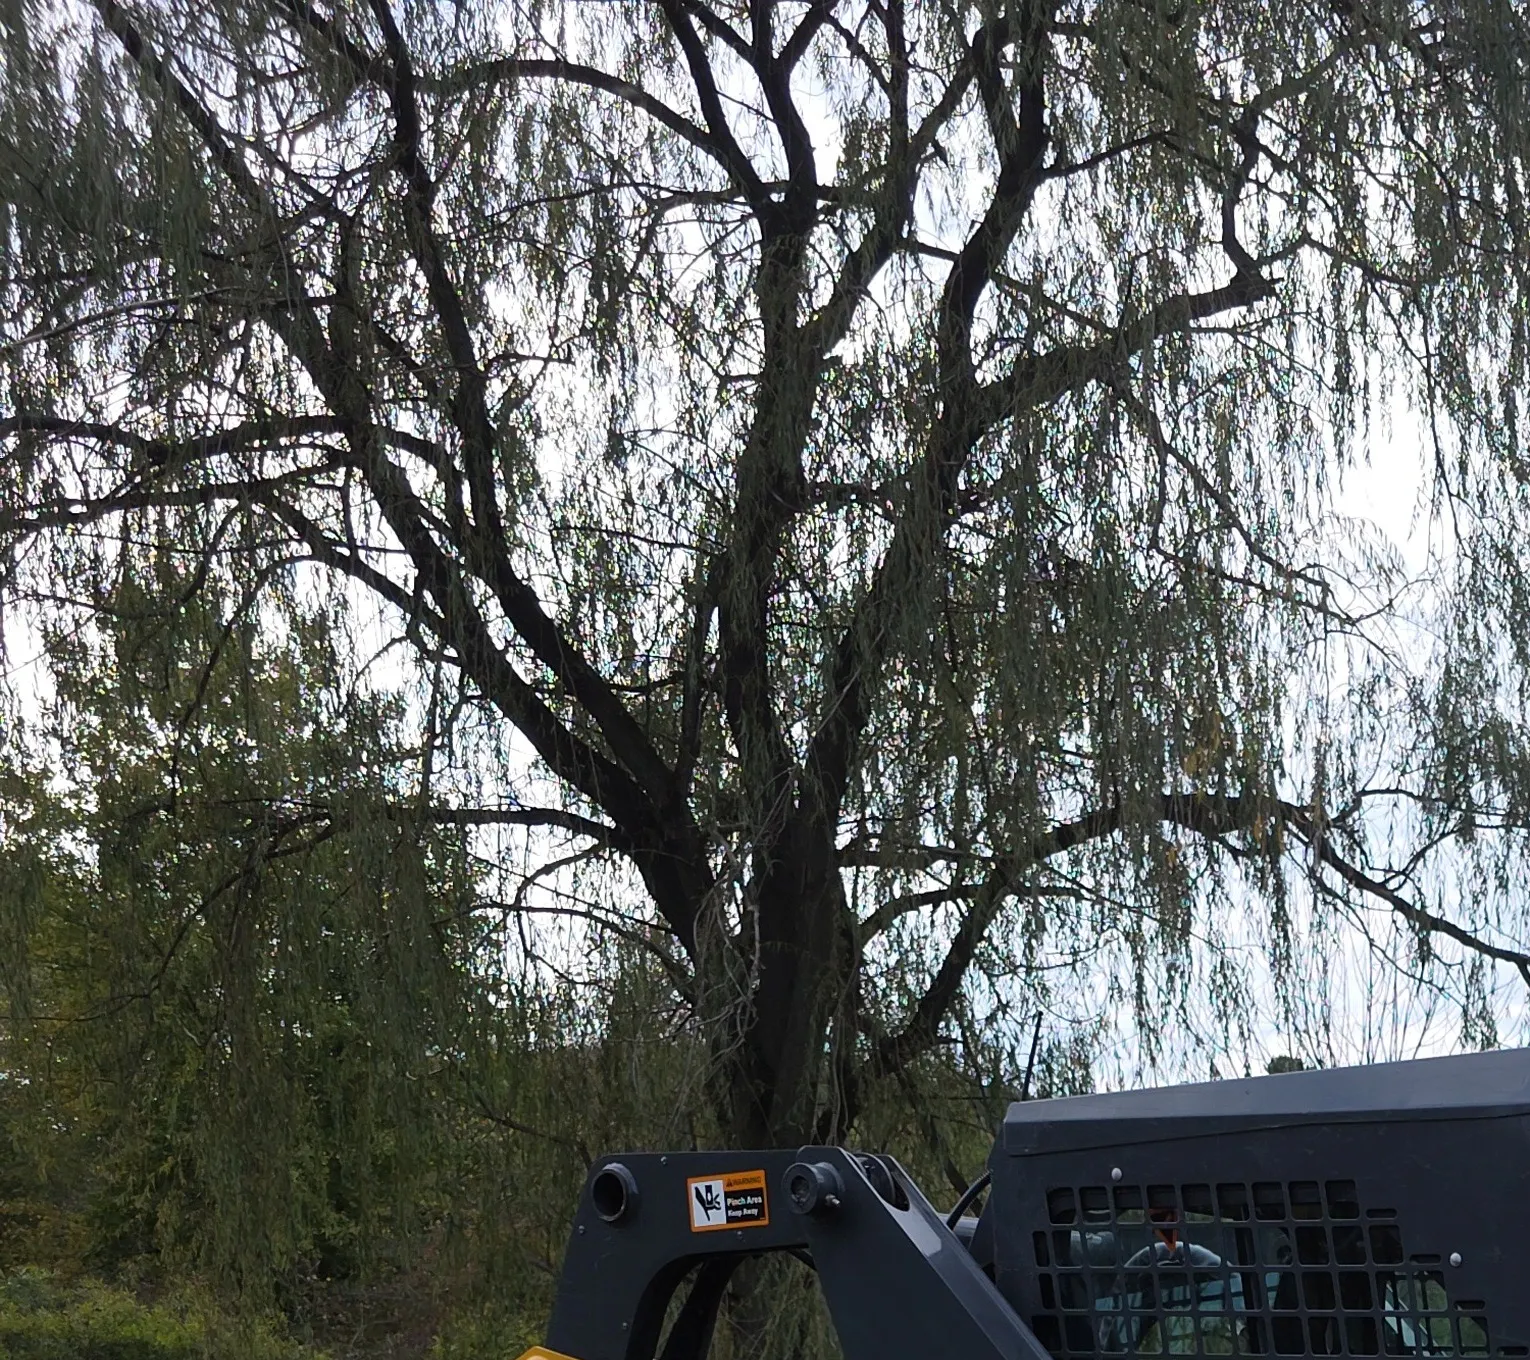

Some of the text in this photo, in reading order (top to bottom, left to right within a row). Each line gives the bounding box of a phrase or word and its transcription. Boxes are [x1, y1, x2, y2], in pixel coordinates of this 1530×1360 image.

[732, 1176, 762, 1186] WARNING
[727, 1195, 763, 1206] Pinch Area
[727, 1208, 759, 1218] Keep Away
